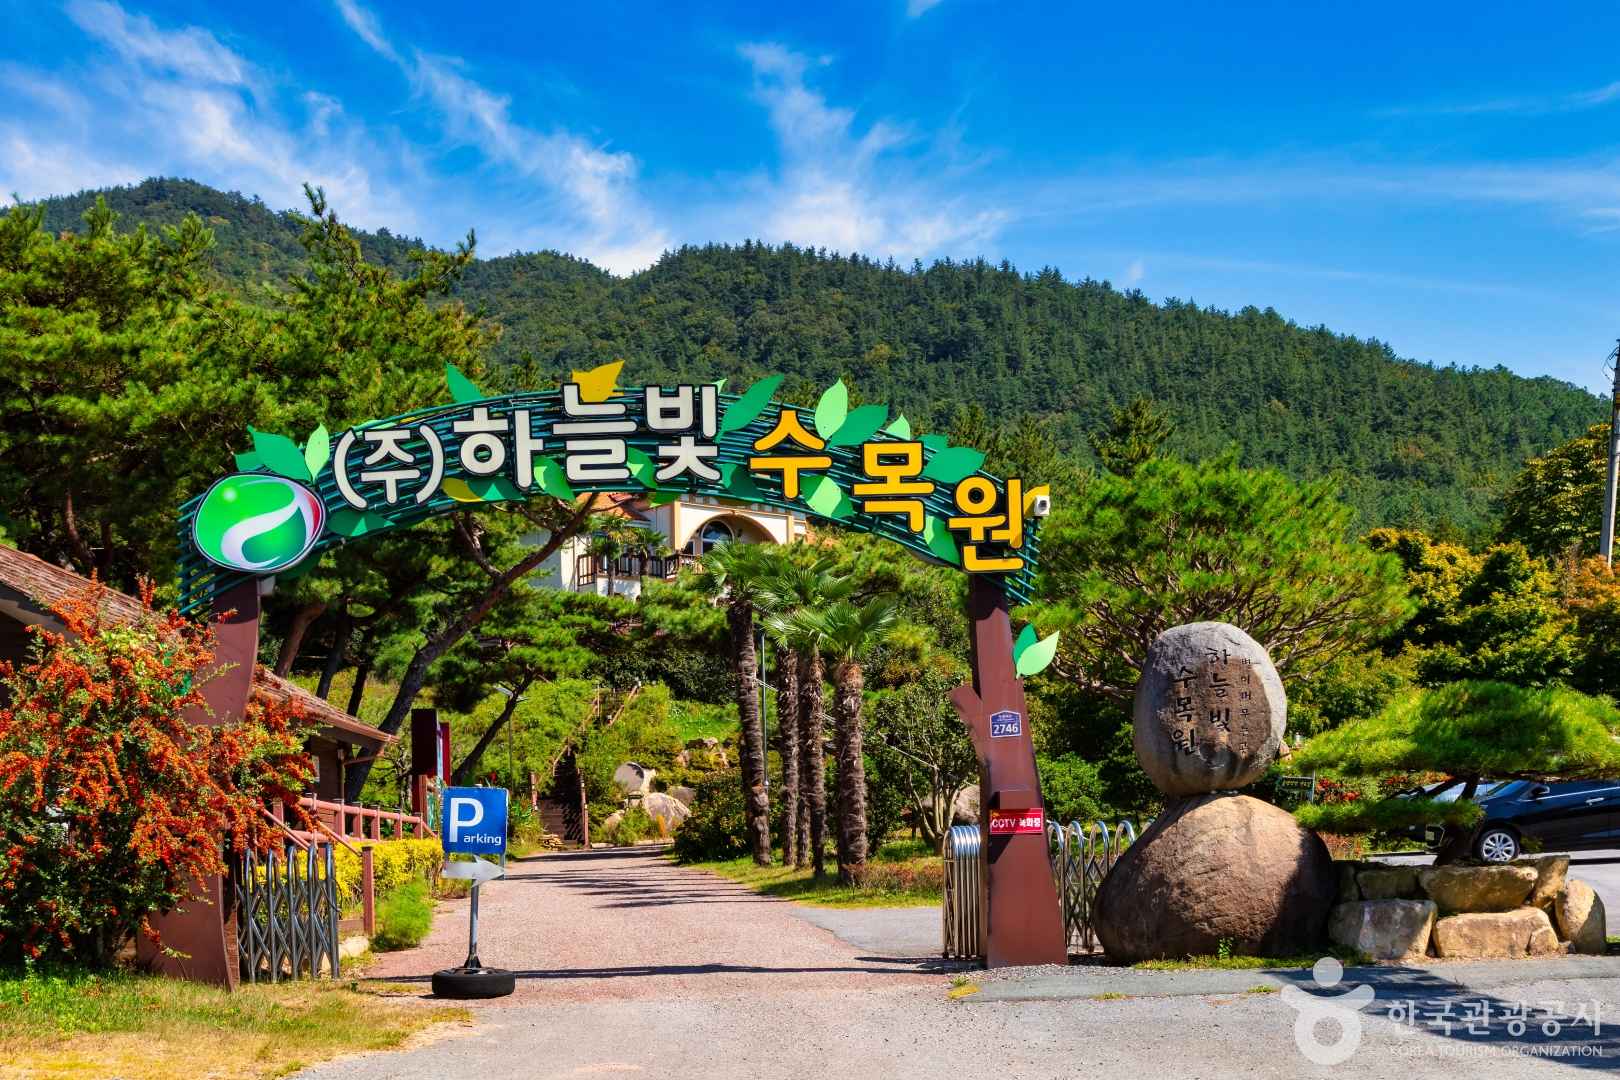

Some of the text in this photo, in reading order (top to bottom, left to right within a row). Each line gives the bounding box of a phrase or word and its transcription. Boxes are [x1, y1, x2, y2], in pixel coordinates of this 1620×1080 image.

[749, 408, 1025, 572] 수목원
[993, 723, 1019, 734] 2746
[992, 818, 1016, 829] CCTV
